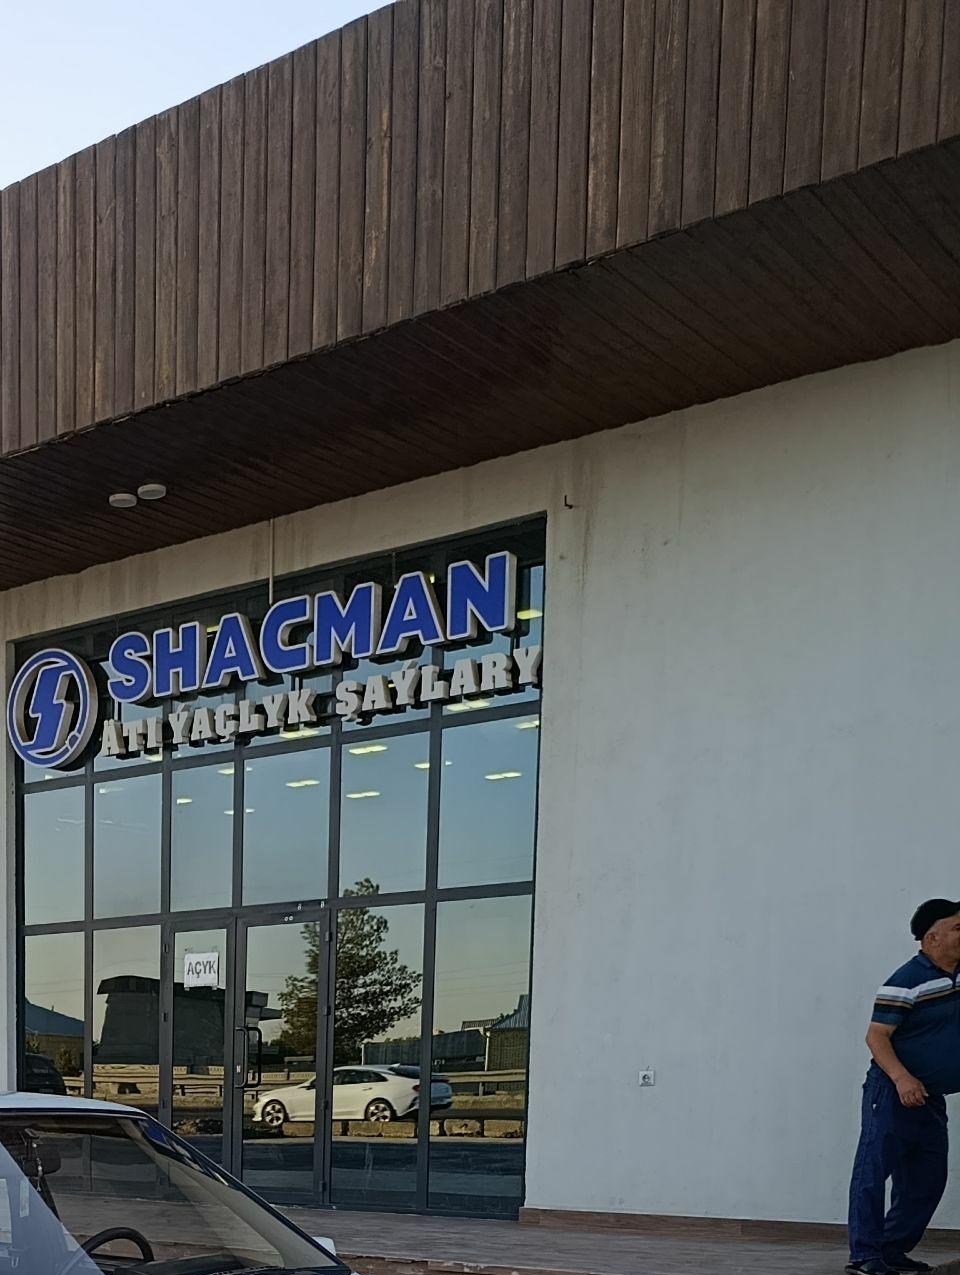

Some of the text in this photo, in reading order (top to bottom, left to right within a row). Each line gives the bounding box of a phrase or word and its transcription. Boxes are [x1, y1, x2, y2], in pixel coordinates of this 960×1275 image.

[107, 551, 518, 703] SHACMAN
[336, 645, 540, 722] ŞAÝLARY
[187, 960, 216, 979] AÇYK
